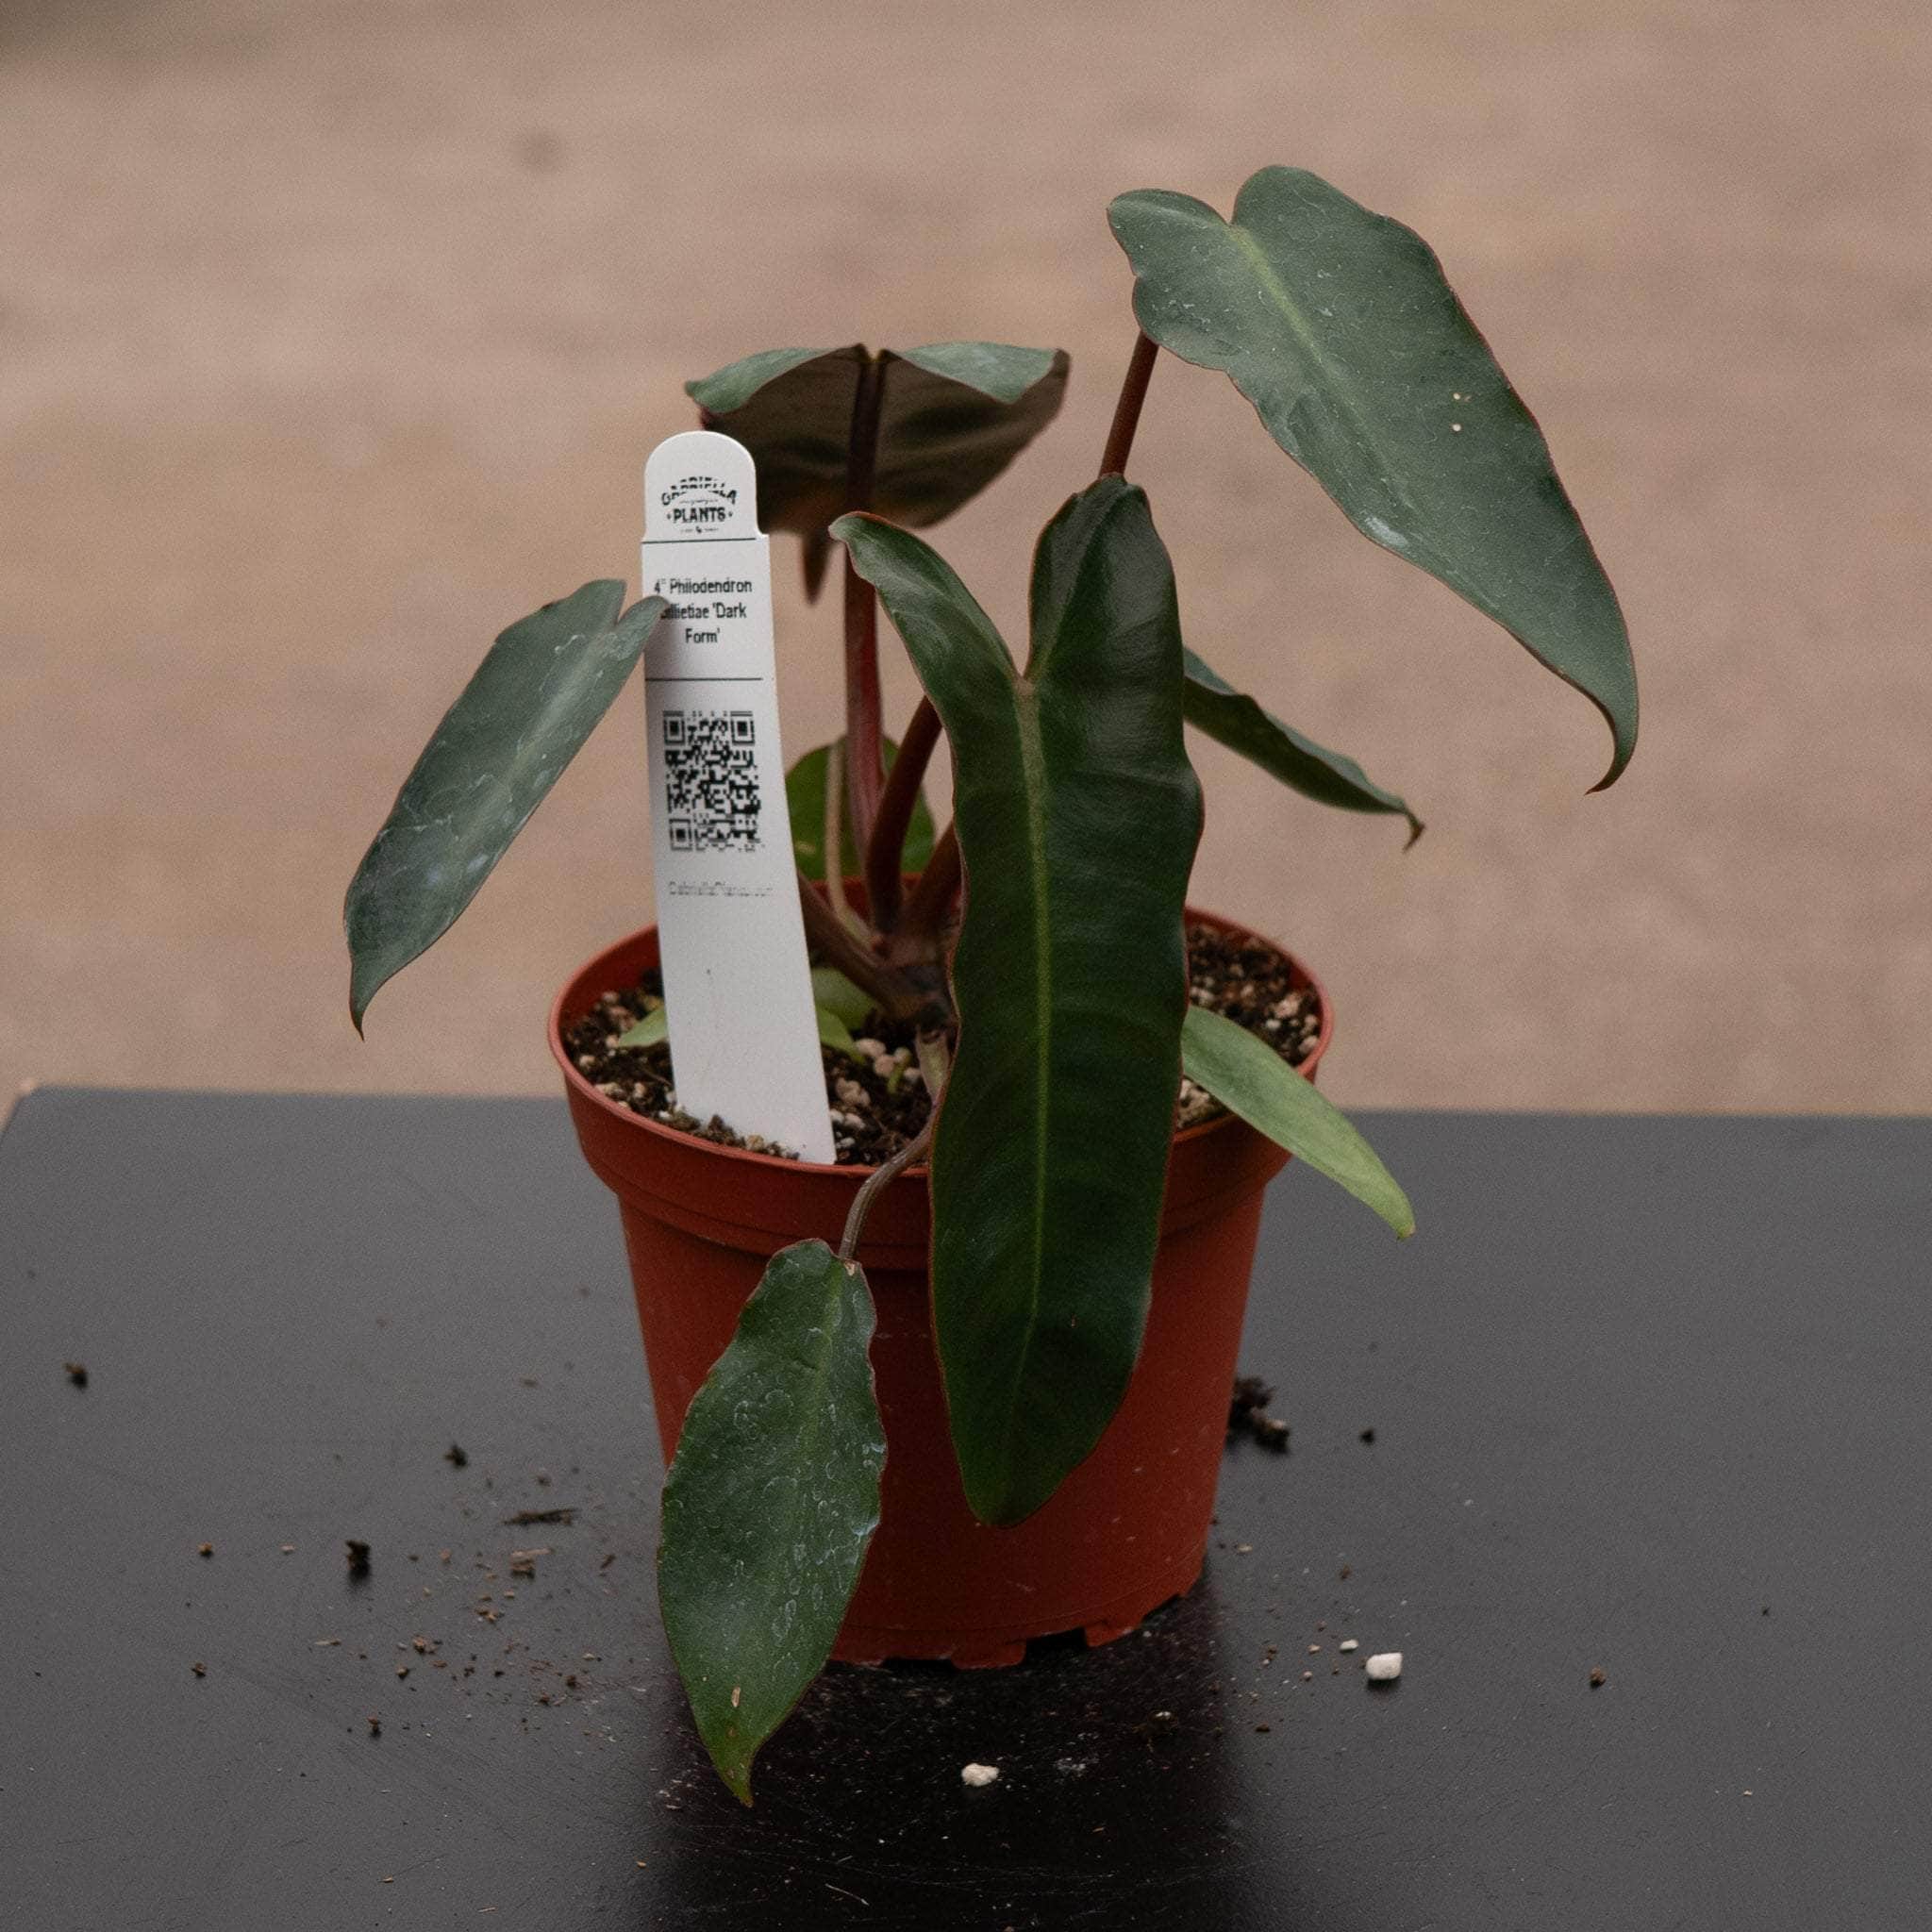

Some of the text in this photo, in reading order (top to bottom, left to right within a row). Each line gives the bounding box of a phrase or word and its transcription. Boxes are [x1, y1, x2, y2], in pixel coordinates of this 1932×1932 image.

[673, 507, 726, 524] PLANTS
[670, 576, 753, 594] Philodendron
[712, 602, 747, 619] 'Dark
[685, 627, 720, 643] Form'
